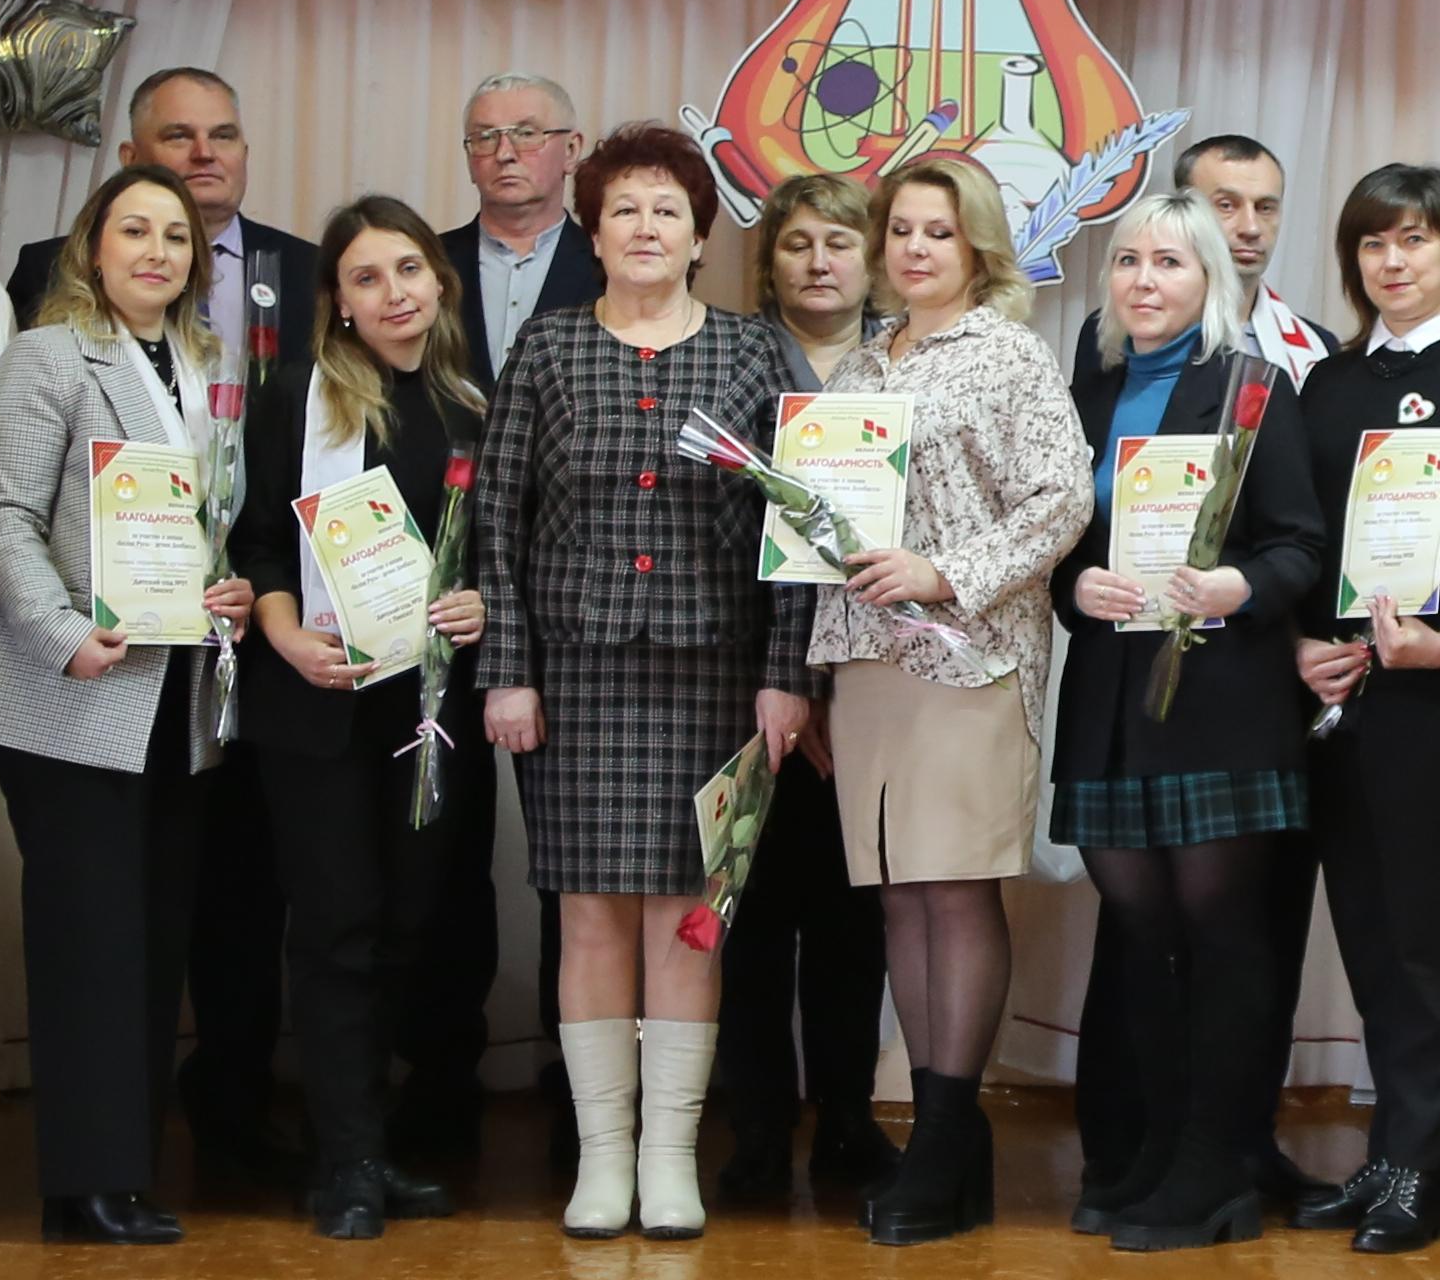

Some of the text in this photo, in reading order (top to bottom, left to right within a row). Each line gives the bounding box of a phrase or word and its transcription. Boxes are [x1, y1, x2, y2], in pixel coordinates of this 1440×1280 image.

[795, 457, 884, 469] БЛАГОДАРНОСТЬ
[1367, 490, 1438, 503] БЛАГОДАРНОСТЬ
[115, 511, 194, 526] БЛАГОДАРНОСТЬ
[340, 533, 406, 567] БЛАГОДАРНОСТЬ
